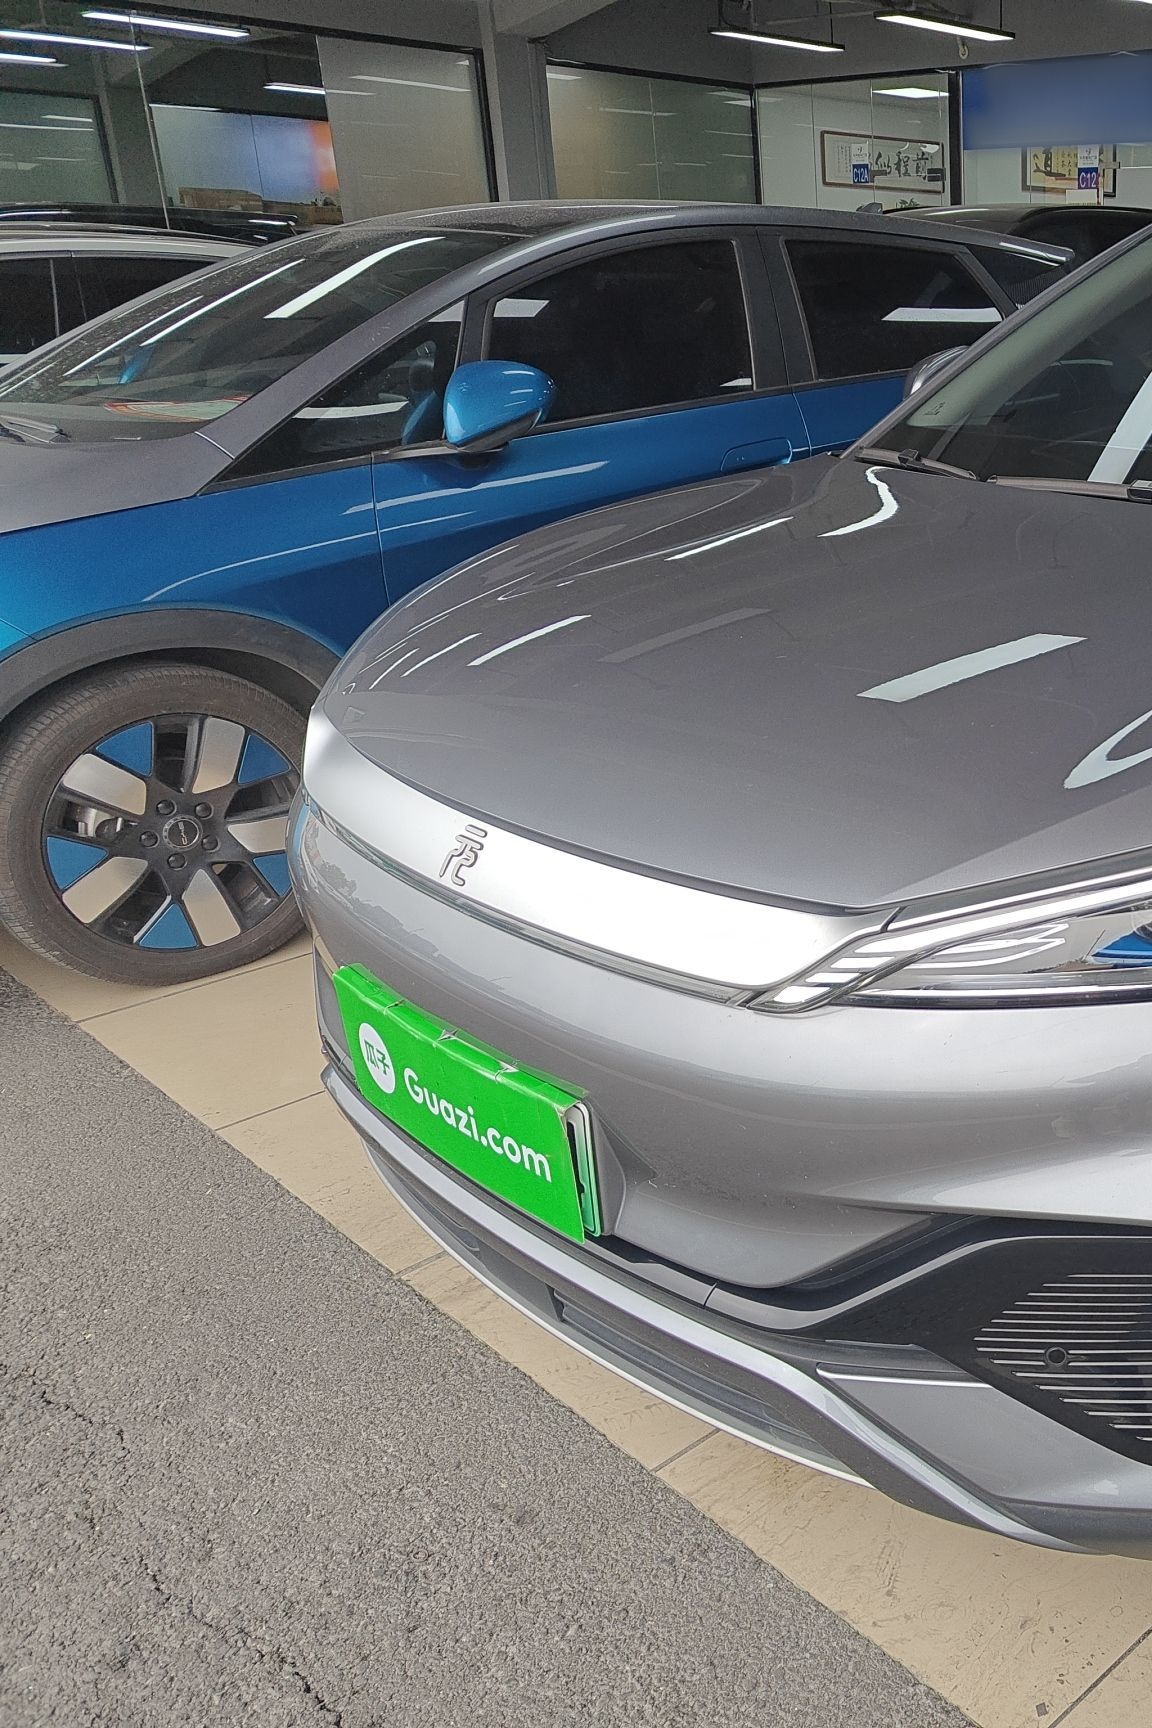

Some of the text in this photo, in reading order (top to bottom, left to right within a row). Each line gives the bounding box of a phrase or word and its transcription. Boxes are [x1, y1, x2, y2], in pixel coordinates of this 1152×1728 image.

[853, 167, 869, 183] C12A
[1079, 172, 1097, 188] C12
[364, 1037, 390, 1076] 瓜子
[402, 1065, 552, 1184] Guazi.com
